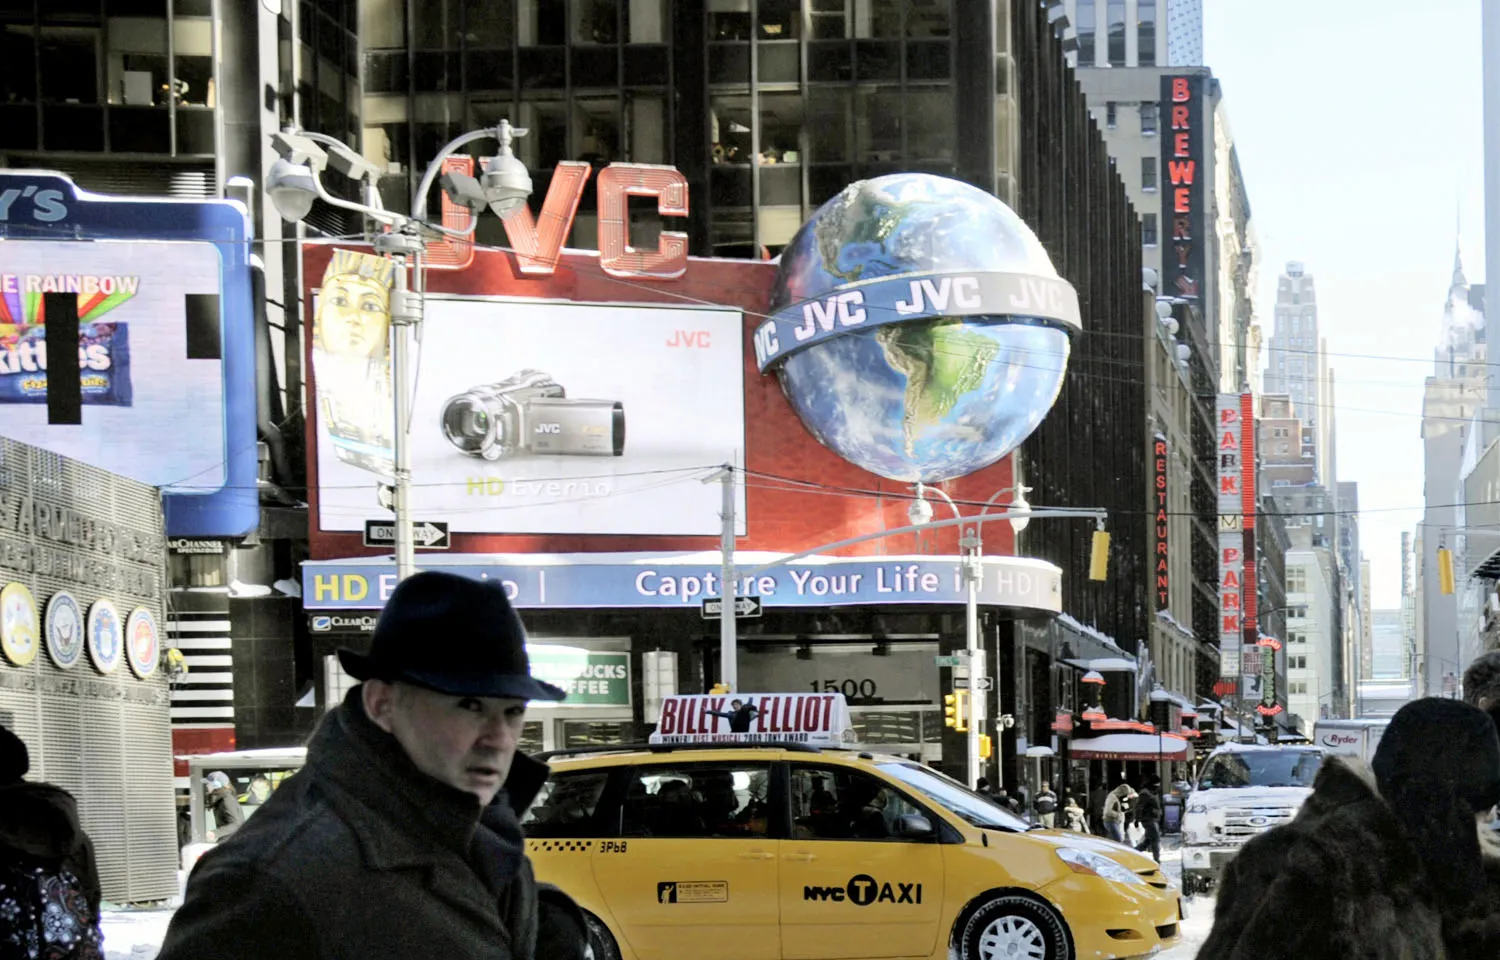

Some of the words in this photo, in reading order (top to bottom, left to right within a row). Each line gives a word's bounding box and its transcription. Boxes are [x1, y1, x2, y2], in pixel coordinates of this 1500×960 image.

[1169, 77, 1195, 268] BREWERY
[384, 154, 690, 281] JVC
[0, 274, 18, 293] E
[26, 274, 138, 296] RAINBOW
[896, 277, 982, 314] JVC
[1010, 278, 1063, 311] JVC
[794, 291, 867, 341] JVC
[666, 329, 710, 348] JVC
[535, 424, 560, 434] JVC
[1220, 409, 1239, 495] PARK
[466, 477, 504, 496] HD
[511, 477, 611, 497] Everio
[377, 527, 394, 538] ON
[1155, 441, 1168, 604] RESTAURANT
[315, 574, 368, 601] HD
[635, 571, 775, 607] Captre
[789, 570, 862, 595] Your
[877, 567, 940, 592] Life
[998, 571, 1030, 595] HD
[1223, 548, 1240, 632] PARK
[811, 679, 876, 698] 1500
[661, 697, 725, 734] BILLY
[757, 696, 834, 733] ELLIOT
[1330, 734, 1358, 744] Ryder
[804, 885, 845, 901] NYC
[848, 874, 922, 905] TAXI
